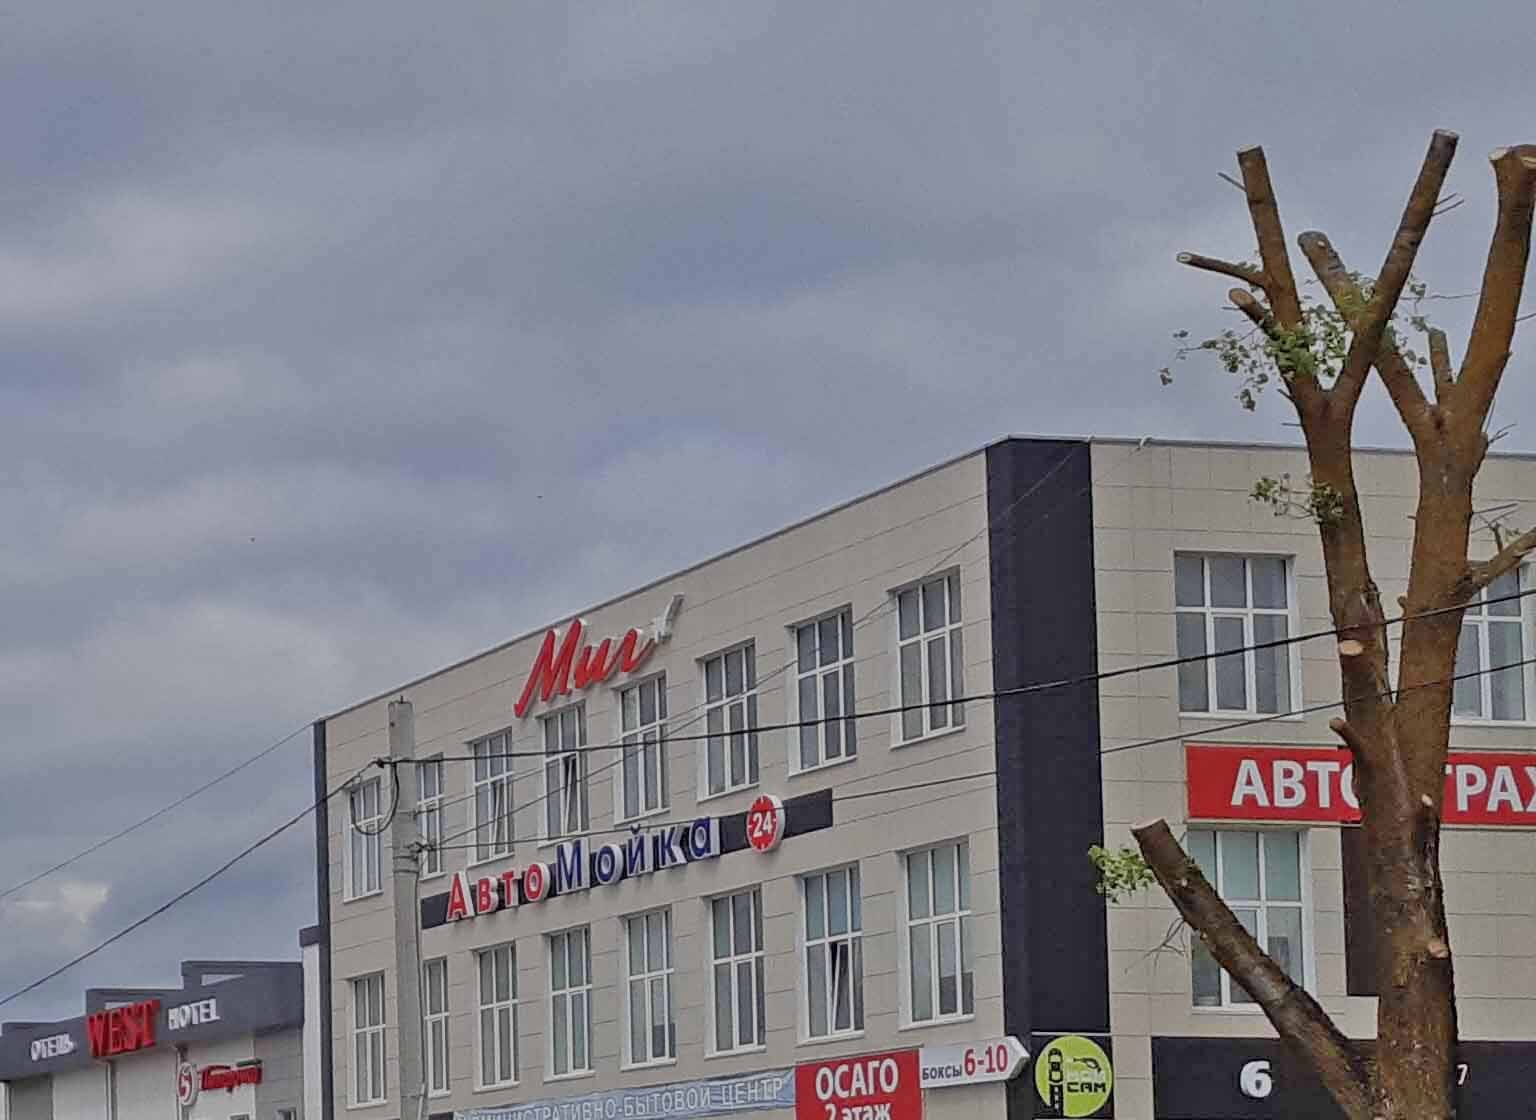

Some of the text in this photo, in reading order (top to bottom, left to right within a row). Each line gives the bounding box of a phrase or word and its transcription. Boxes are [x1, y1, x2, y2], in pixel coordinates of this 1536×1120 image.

[752, 811, 773, 838] 24
[86, 999, 161, 1057] WEST
[168, 998, 221, 1031] HOTEL
[815, 1057, 899, 1101] ОСАГО
[922, 1044, 1009, 1081] БОКСЫ 6-10
[1239, 1060, 1273, 1098] 6
[721, 1076, 785, 1109] ЦЕНТР
